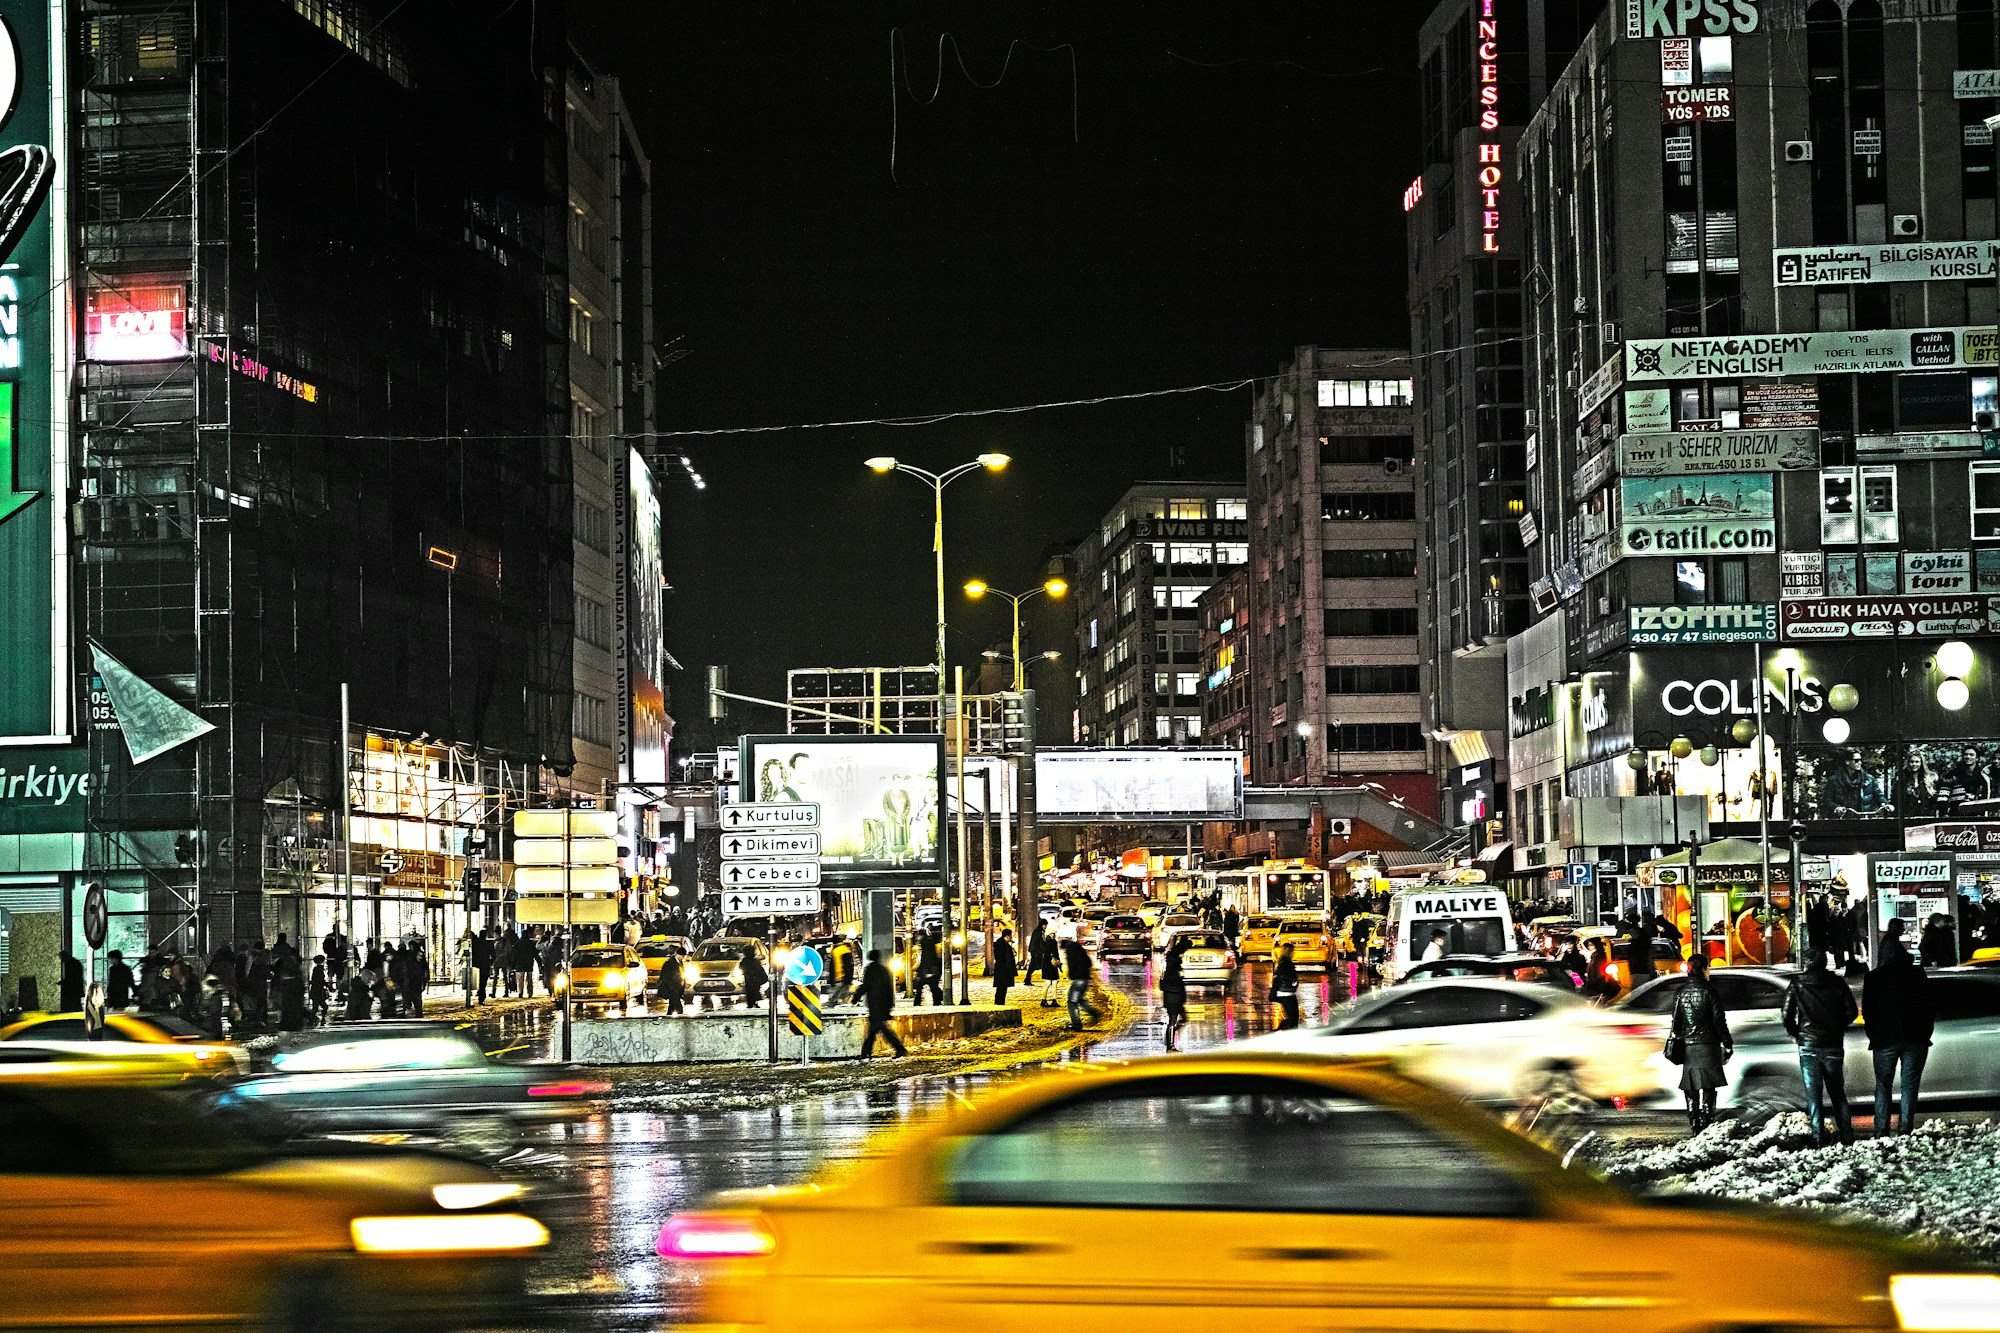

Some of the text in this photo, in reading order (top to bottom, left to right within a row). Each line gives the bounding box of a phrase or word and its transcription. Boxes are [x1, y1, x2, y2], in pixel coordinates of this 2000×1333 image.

[1629, 0, 1640, 37] RDEM
[1644, 0, 1759, 37] KPSS
[1958, 72, 2000, 88] ATA
[1665, 87, 1730, 104] TÖMER
[1667, 105, 1693, 120] YÖS
[1703, 105, 1730, 118] YDS
[1479, 144, 1500, 252] HOTEL
[1805, 249, 1865, 268] yalçın
[1880, 246, 1978, 263] BİLGİSAYAR
[1805, 267, 1871, 282] BATIFEN
[1848, 335, 1869, 344] YDS
[1922, 333, 1943, 342] with
[1671, 337, 1812, 357] NETACADEMY
[1825, 347, 1894, 358] TOEFL IELTS
[1915, 344, 1950, 354] CALLAN
[1696, 356, 1783, 375] ENGLISH
[1814, 360, 1904, 371] HAZIRLIK ATLAMA
[1917, 356, 1950, 365] Method
[1680, 433, 1778, 458] SEHER TURİZM
[1630, 450, 1656, 460] THY
[1655, 525, 1774, 549] tatil.com
[1910, 555, 1964, 572] öykü
[1785, 574, 1820, 586] KIBRIS
[1911, 574, 1964, 589] tour
[1808, 602, 1851, 618] TÜRK
[1857, 603, 1905, 616] HAVA
[1859, 622, 1906, 630] PEGASS
[1631, 633, 1659, 643] 430
[1662, 633, 1679, 642] 47
[1682, 632, 1700, 642] 47
[747, 809, 813, 821] Kurtuluş
[747, 838, 813, 850] Dikimevi
[747, 867, 809, 879] Cebeci
[1573, 865, 1587, 884] P
[748, 895, 813, 907] Mamak
